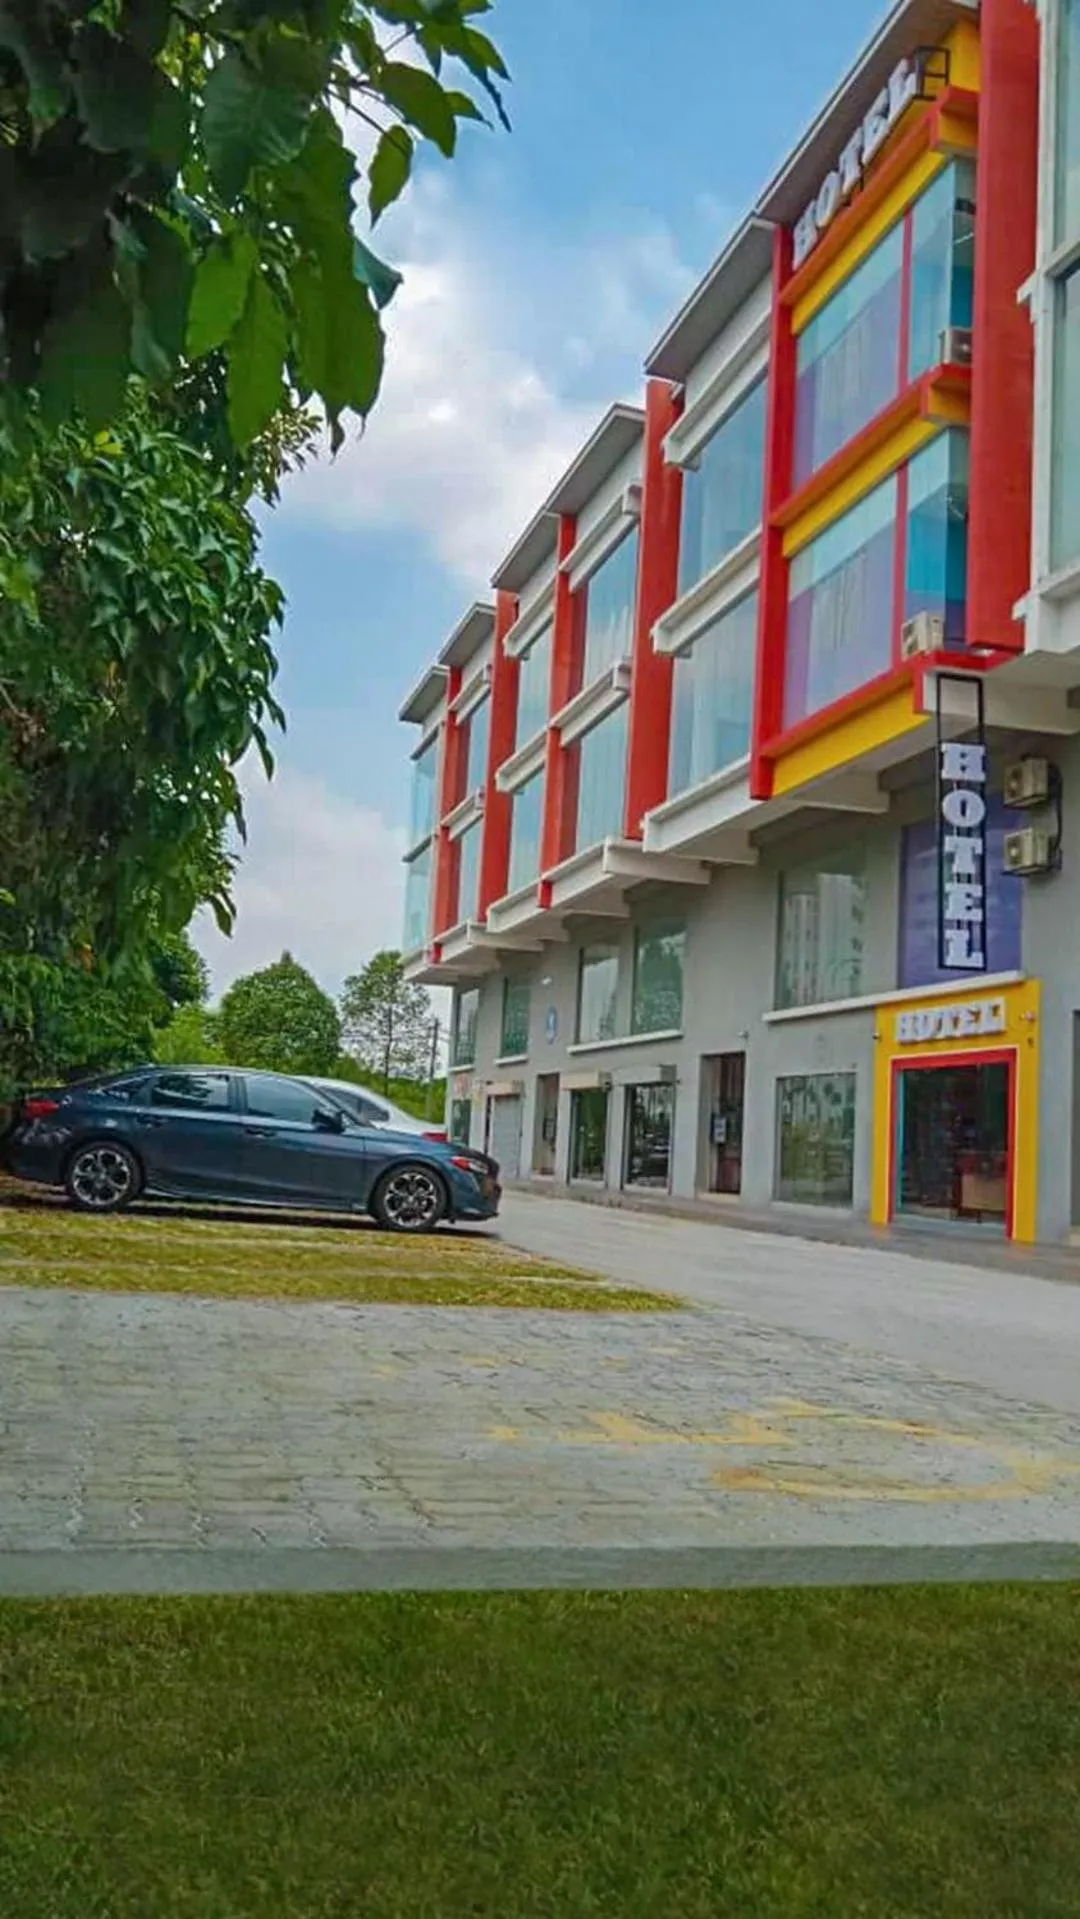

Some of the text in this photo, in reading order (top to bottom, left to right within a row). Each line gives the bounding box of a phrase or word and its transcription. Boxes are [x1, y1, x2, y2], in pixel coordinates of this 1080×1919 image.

[793, 58, 918, 270] HOTEL
[942, 743, 985, 967] HOTEL
[897, 997, 1004, 1042] HOTEL
